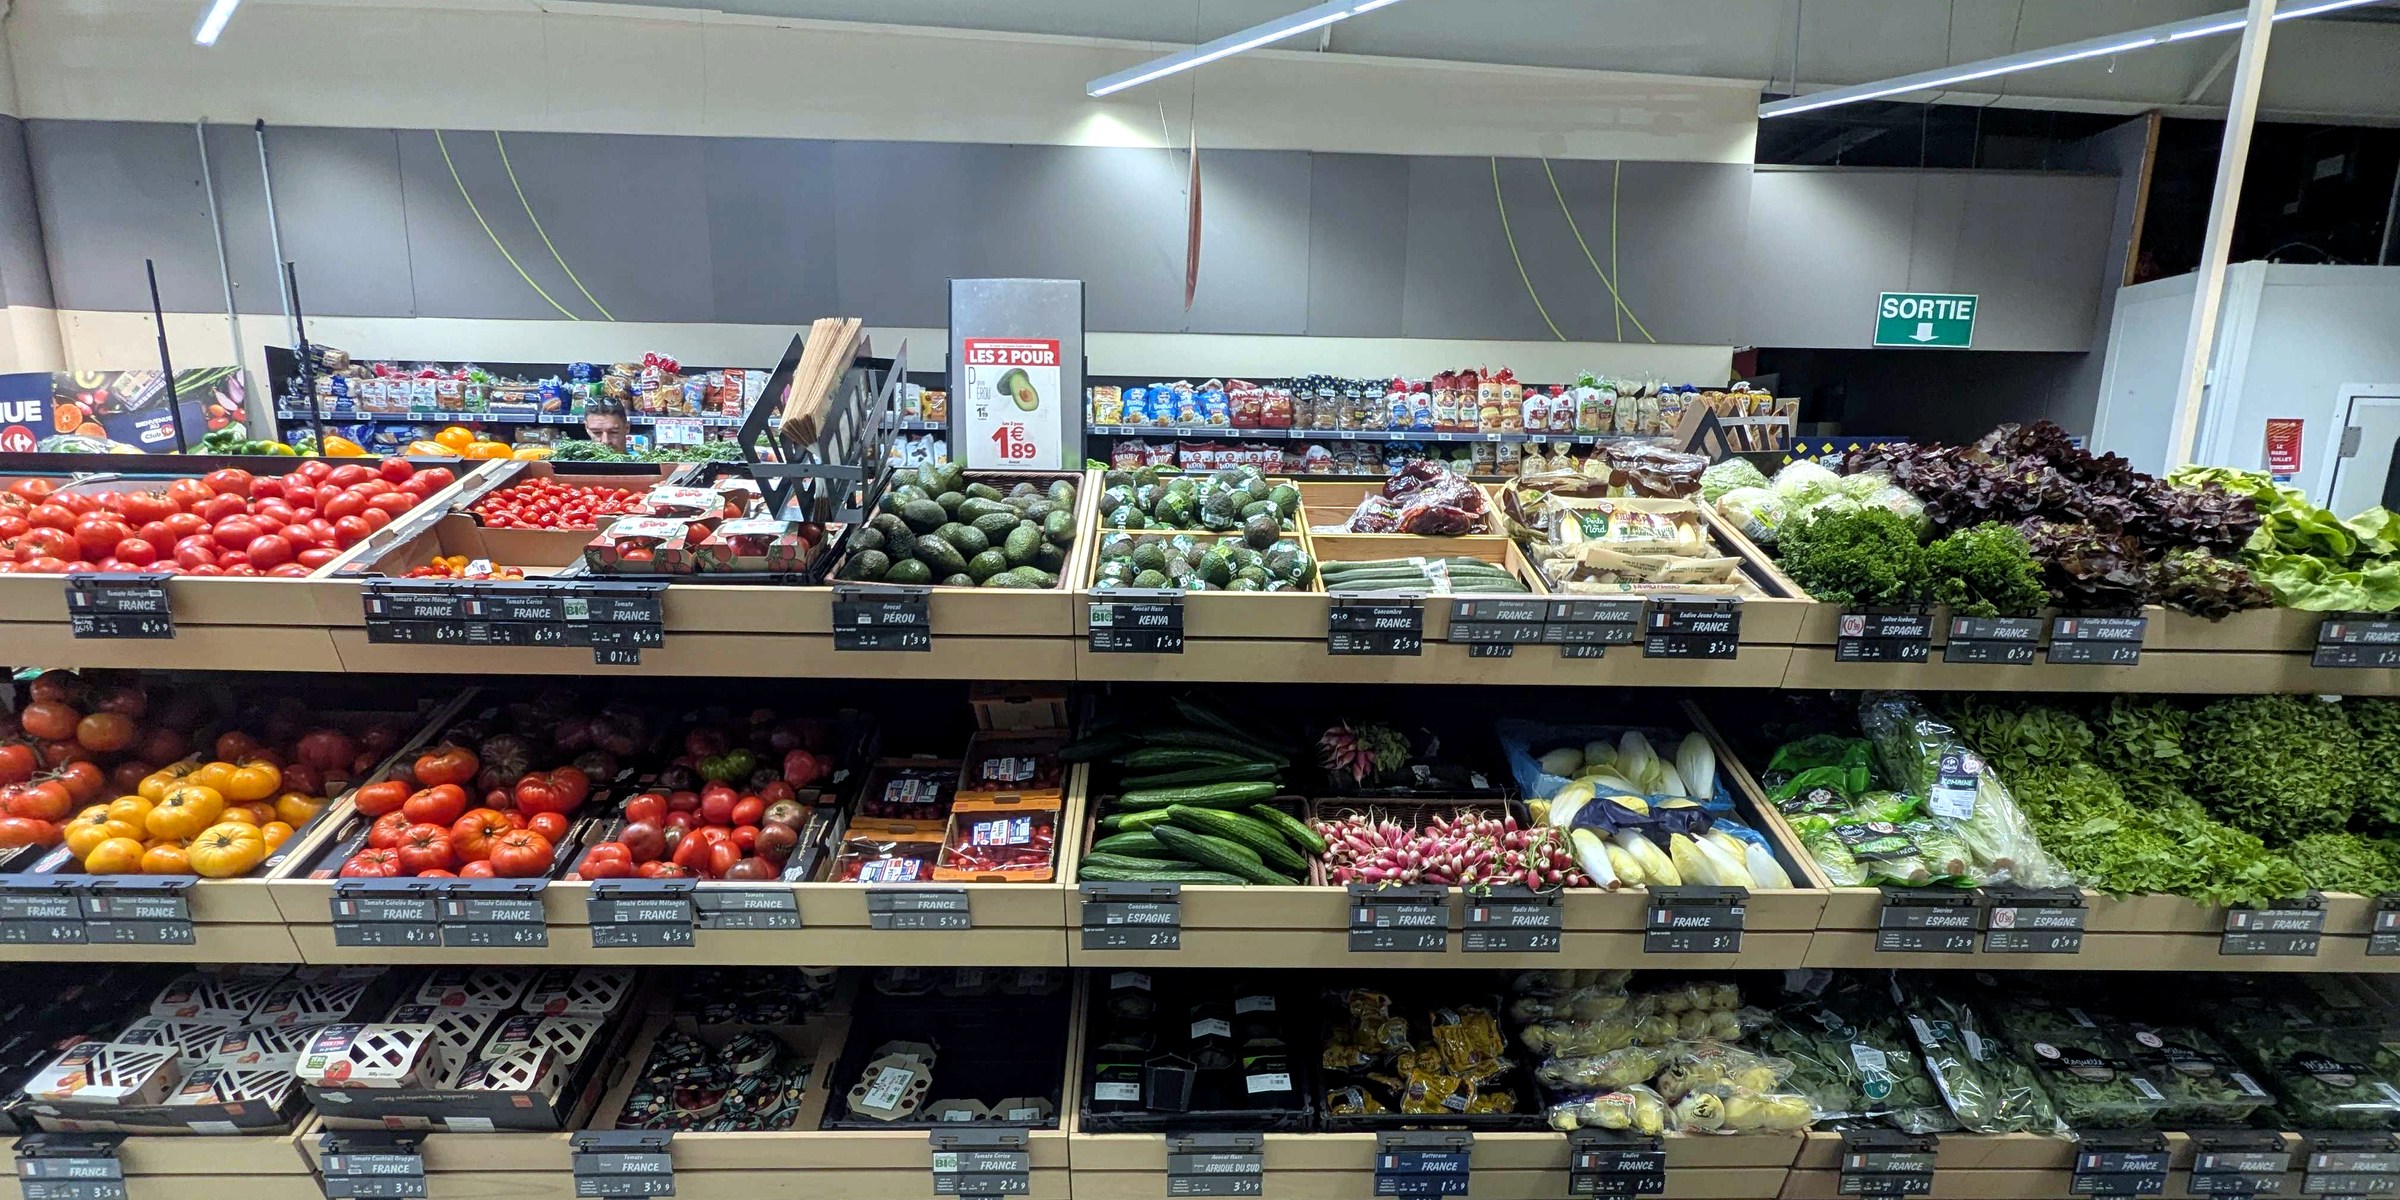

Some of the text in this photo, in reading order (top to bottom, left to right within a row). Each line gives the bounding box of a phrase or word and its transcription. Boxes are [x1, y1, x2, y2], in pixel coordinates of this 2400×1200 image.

[1882, 298, 1972, 320] SORTIE
[969, 350, 1055, 364] LES 2 POUR
[144, 431, 161, 439] Club
[119, 600, 156, 610] FRANCE
[414, 606, 452, 616] FRANCE
[514, 608, 551, 618] FRANCE
[566, 605, 588, 616] BIO
[613, 610, 650, 621] FRANCE
[1496, 610, 1532, 620] FRANCE
[883, 612, 915, 623] PÉROU
[1092, 612, 1113, 622] BIO
[1138, 615, 1168, 626] KENYA
[1593, 611, 1630, 621] FRANCE
[1375, 617, 1412, 628] FRANCE
[1692, 622, 1729, 632] FRANCE
[1882, 625, 1924, 636] ESPAGNE
[1992, 628, 2029, 638] FRANCE
[2097, 628, 2134, 638] FRANCE
[2364, 632, 2400, 642] FRANCE
[744, 900, 783, 909] FRANCE
[918, 900, 956, 910] FRANCE
[27, 906, 67, 916] FRANCE
[136, 906, 175, 917] FRANCE
[383, 908, 422, 919] FRANCE
[492, 910, 531, 920] FRANCE
[639, 909, 678, 920] FRANCE
[1127, 912, 1172, 924] ESPAGNE
[1398, 915, 1436, 926] FRANCE
[1512, 915, 1550, 926] FRANCE
[1672, 917, 1710, 927] FRANCE
[1926, 916, 1970, 927] ESPAGNE
[2034, 916, 2077, 927] ESPAGNE
[2272, 920, 2310, 930] FRANCE
[622, 1162, 660, 1172] FRANCE
[935, 1159, 958, 1168] BIO
[980, 1161, 1018, 1171] FRANCE
[1206, 1164, 1260, 1173] AFRIQUE DU SUD
[1422, 1161, 1458, 1172] FRANCE
[1618, 1161, 1655, 1170] FRANCE
[1886, 1162, 1924, 1172] FRANCE
[2122, 1161, 2158, 1170] FRANCE
[2238, 1161, 2276, 1170] FRANCE
[2352, 1162, 2388, 1170] FRANCE
[70, 1166, 109, 1177] FRANCE
[372, 1164, 410, 1174] FRANCE
